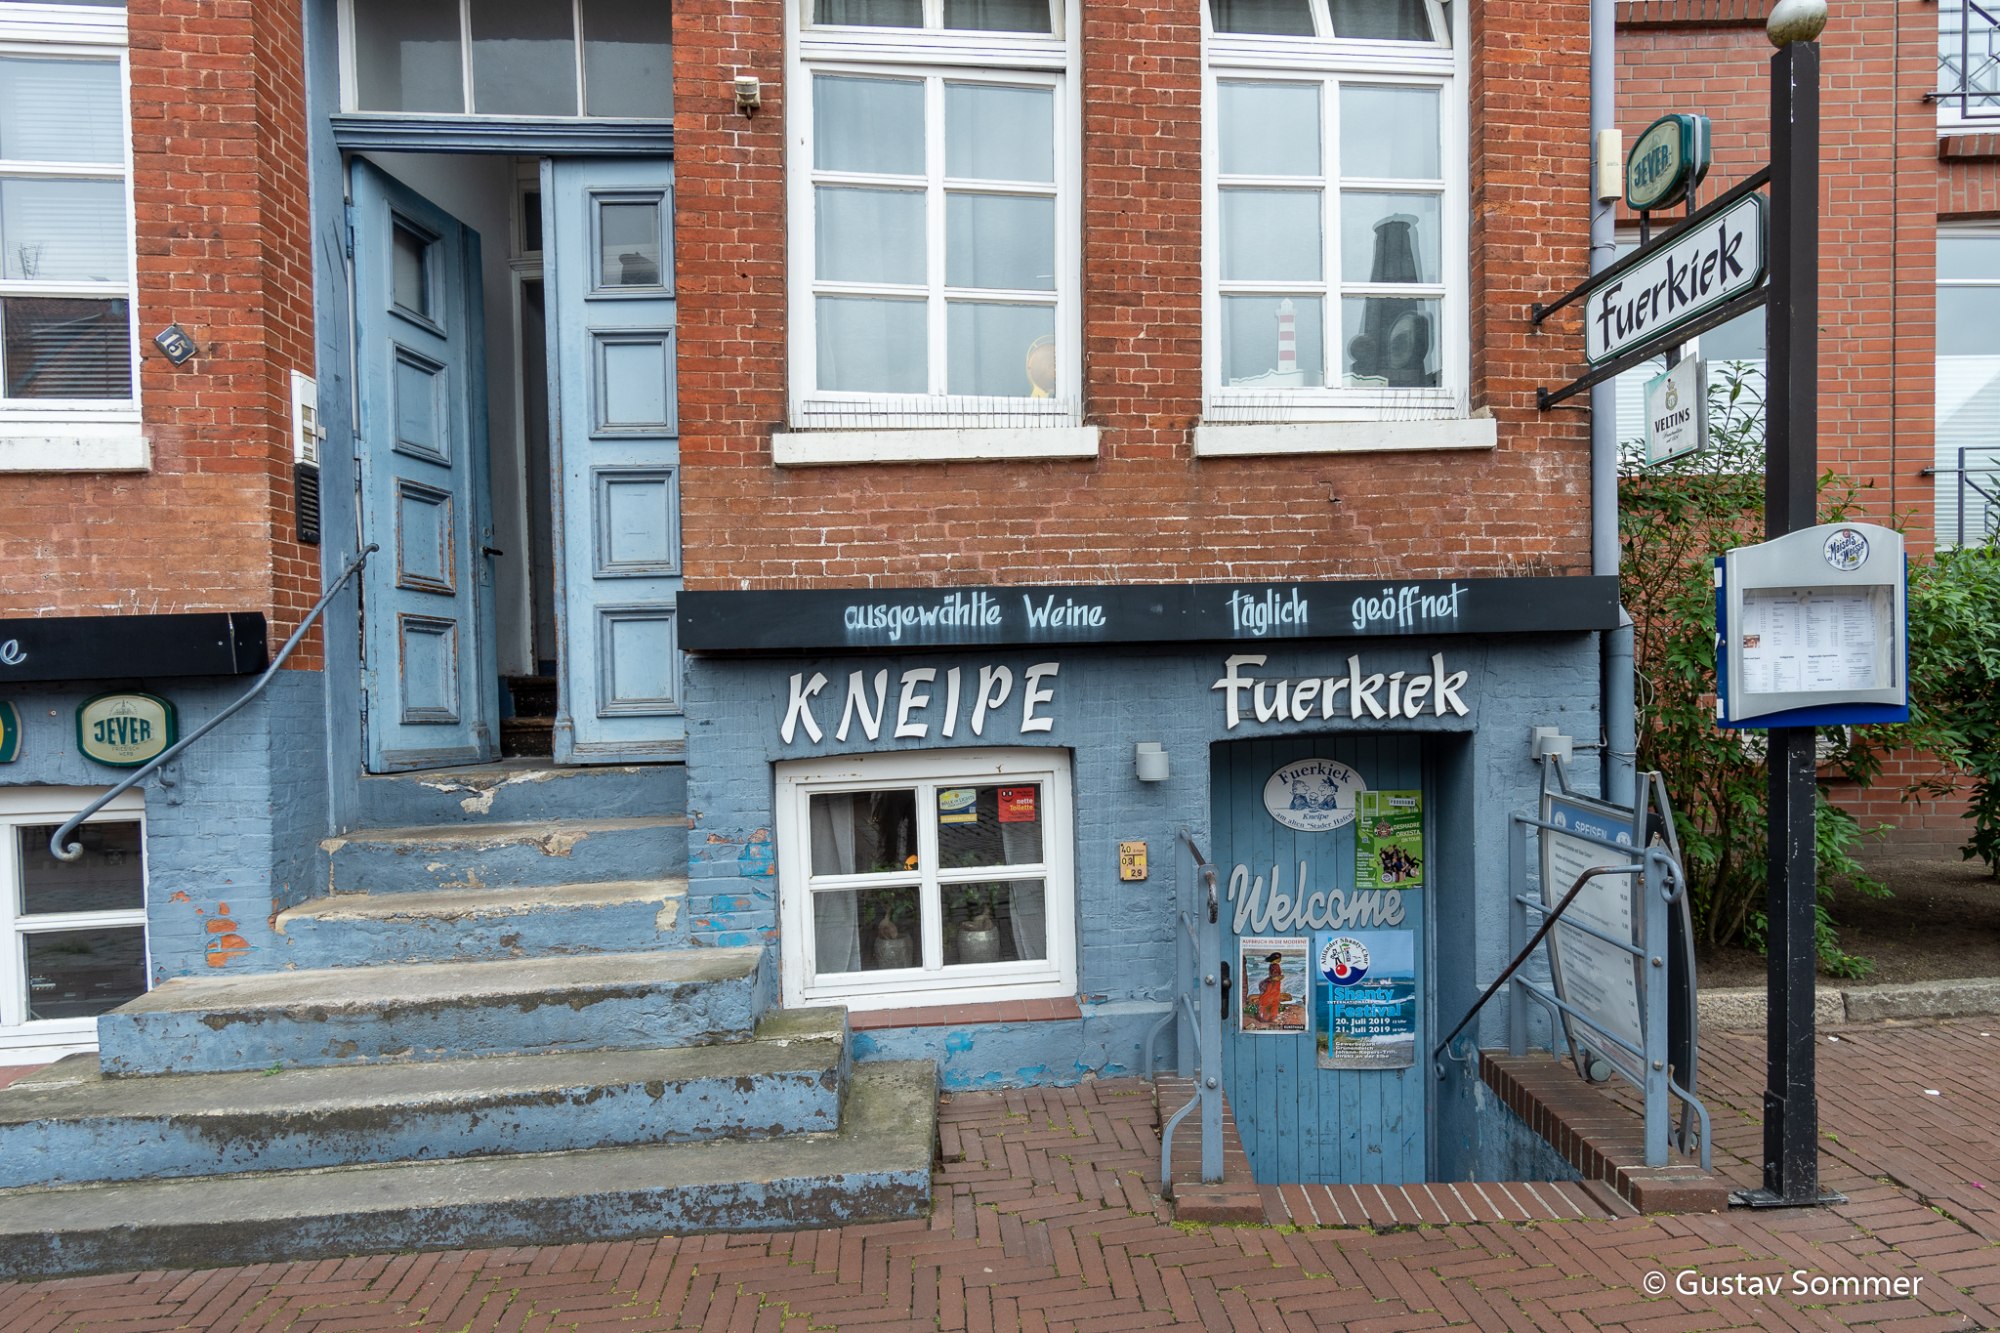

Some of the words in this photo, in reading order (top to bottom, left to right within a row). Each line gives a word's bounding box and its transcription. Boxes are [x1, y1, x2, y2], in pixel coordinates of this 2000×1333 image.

[1634, 144, 1669, 187] JEVER
[1596, 222, 1743, 353] Fuerkiek
[160, 333, 188, 357] 15
[1655, 407, 1690, 433] VELTINS
[844, 592, 1002, 641] ausgewählte
[1022, 594, 1106, 628] Weine
[1225, 587, 1308, 636] täglich
[1352, 582, 1469, 630] geöffnet
[780, 662, 1060, 745] KNEIPE
[1211, 652, 1470, 731] Fuerkiek
[93, 716, 152, 745] JEVER
[1278, 762, 1352, 786] Fuerkiek
[1574, 821, 1607, 840] SPEISEN
[1227, 860, 1406, 935] Welcome
[1334, 987, 1394, 1003] Shanty
[1334, 1003, 1402, 1017] Festival
[1350, 1018, 1366, 1026] Juli
[1350, 1026, 1366, 1034] Juli
